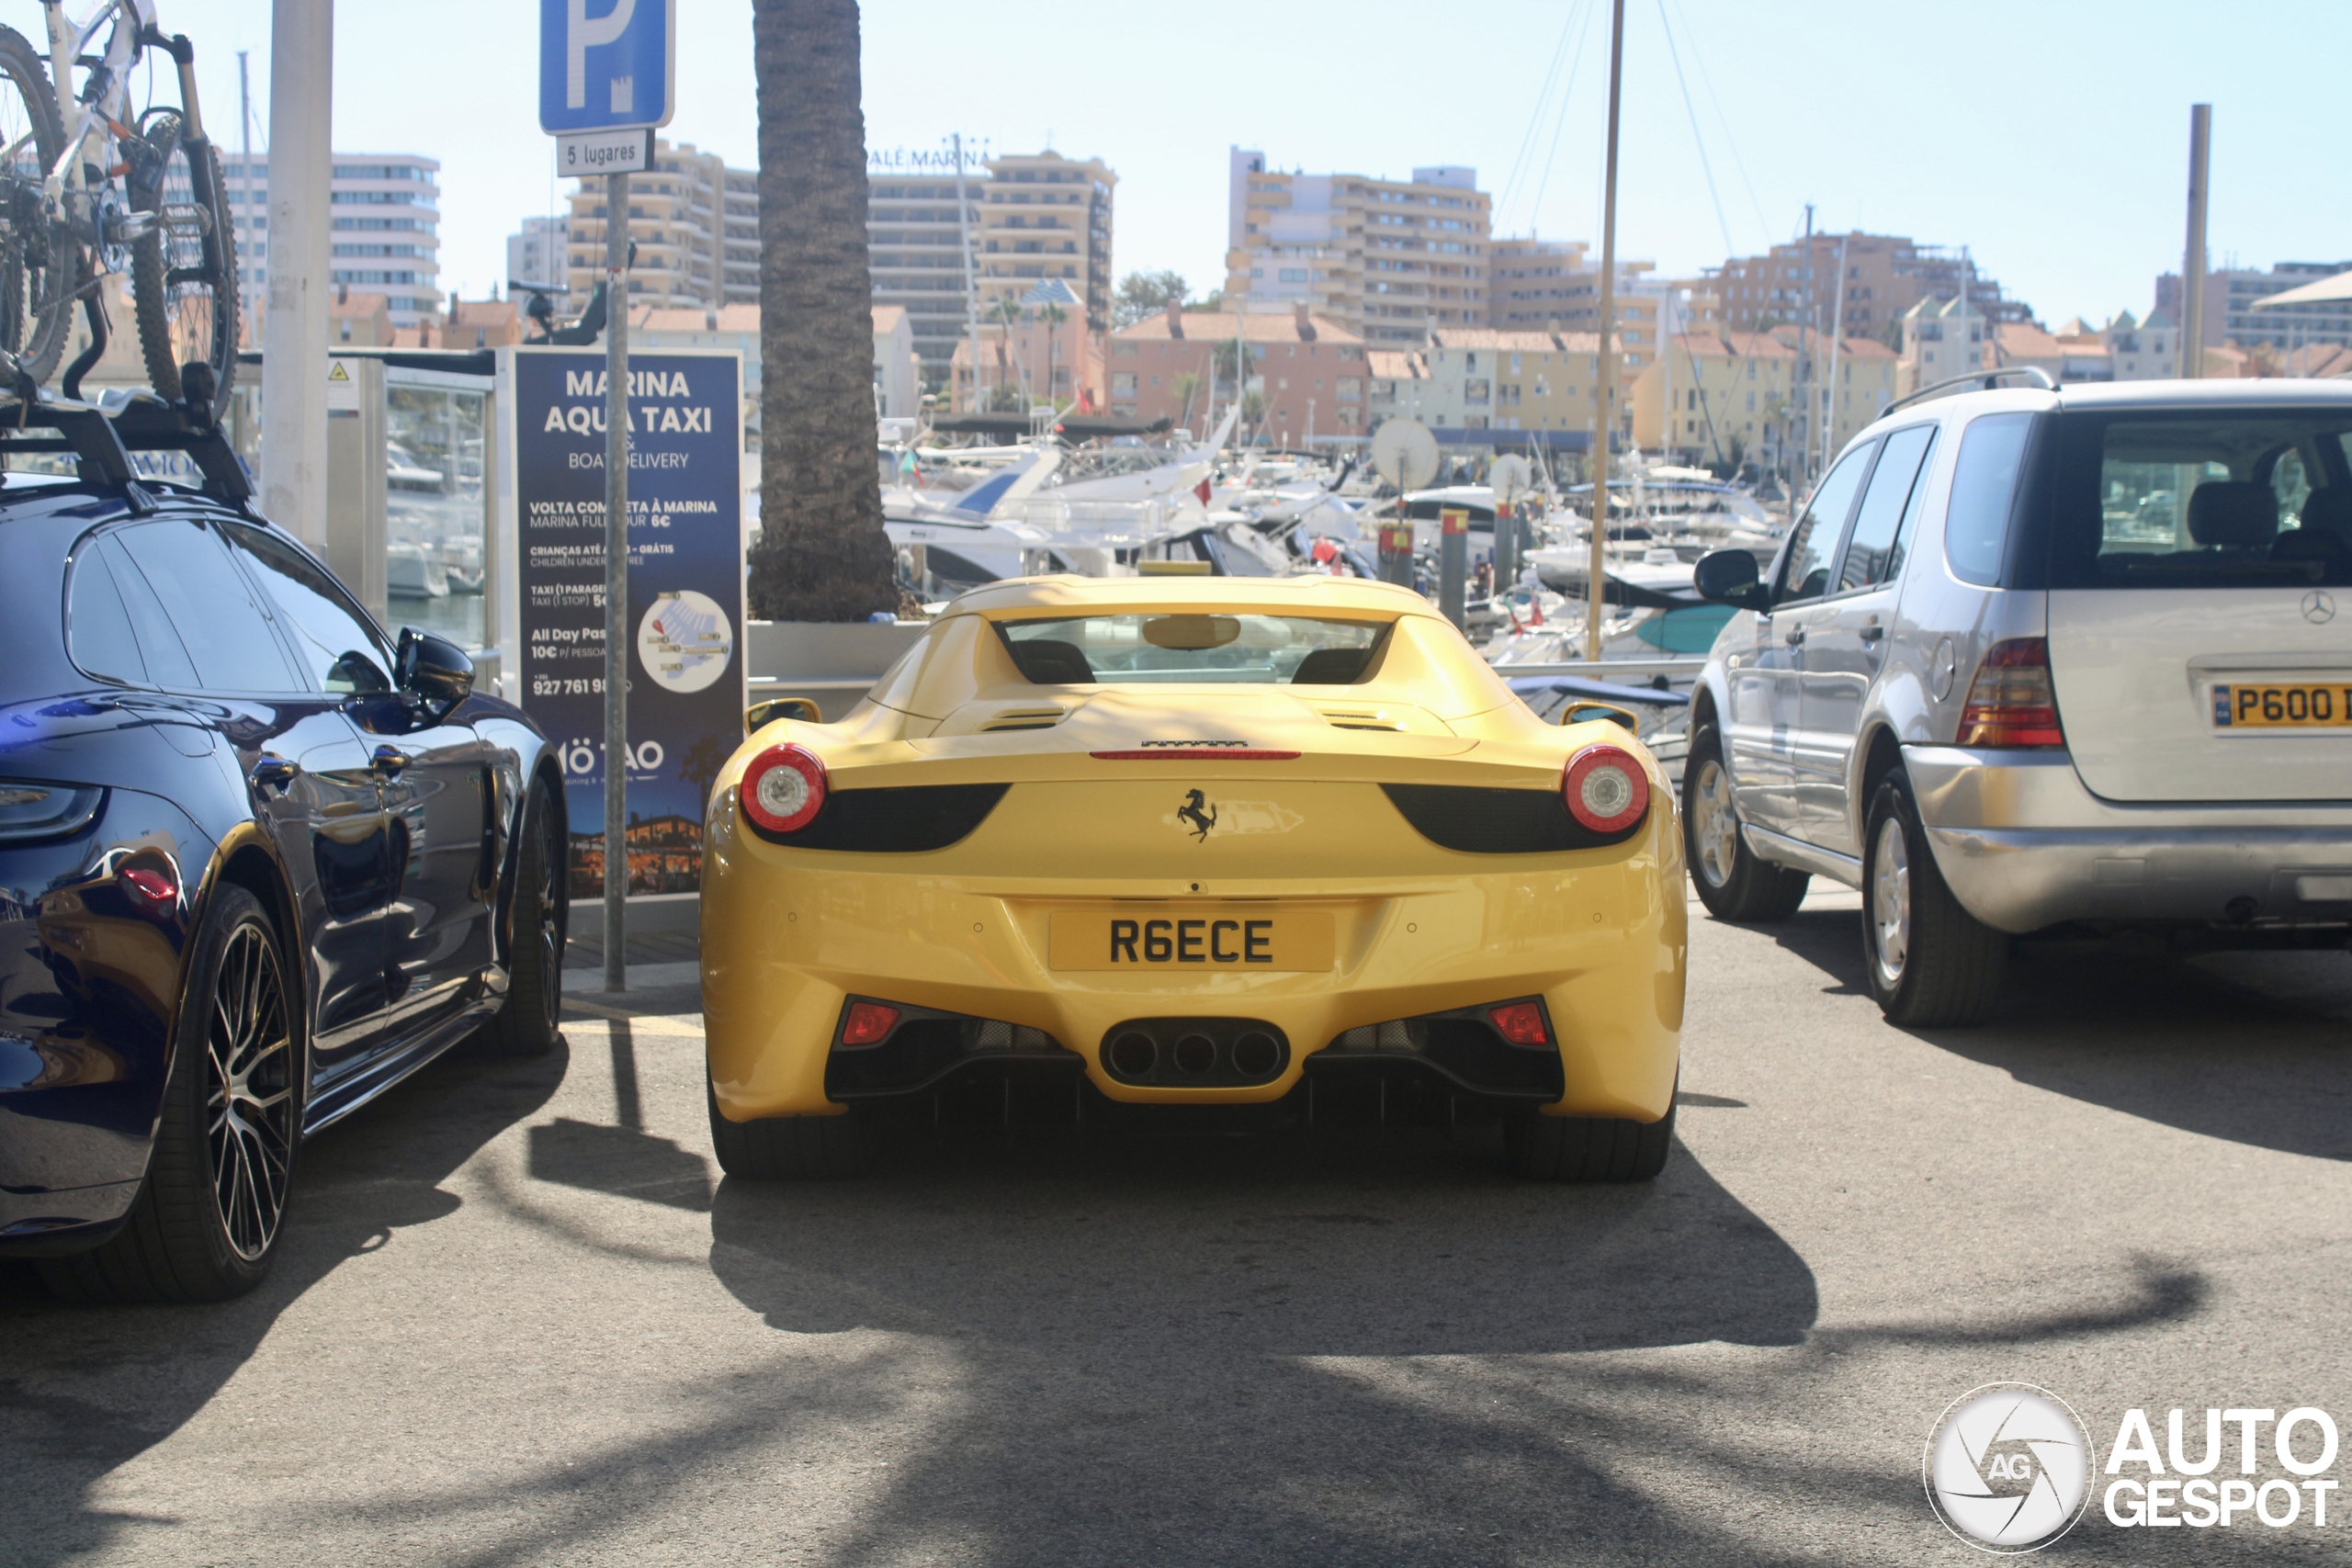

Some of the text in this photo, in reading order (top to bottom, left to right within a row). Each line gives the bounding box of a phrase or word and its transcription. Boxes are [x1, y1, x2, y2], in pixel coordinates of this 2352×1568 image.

[567, 0, 636, 108] P
[568, 144, 635, 166] 5 lugares
[869, 144, 989, 167] ALÉ MARNA
[641, 407, 711, 433] TAXI
[569, 453, 688, 469] BOA ELIVERY
[530, 502, 573, 514] VOLTA
[577, 501, 649, 513] COMETA
[663, 501, 717, 513] MARINA
[530, 515, 579, 528] MARINA
[650, 514, 671, 527] 6€
[530, 546, 581, 558] CRIANÇAS
[583, 543, 600, 555] ATÉ
[639, 542, 673, 554] GRÁTIS
[530, 557, 574, 567] CHILDREN
[531, 585, 553, 595] TAXI
[566, 584, 606, 595] PARAGE
[531, 596, 550, 605] TAXI
[532, 627, 606, 644] All Day Pas
[532, 646, 557, 659] 10€
[533, 681, 560, 695] 927
[564, 680, 589, 694] 761
[2238, 689, 2333, 720] P600
[1111, 919, 1273, 963] R6ECE
